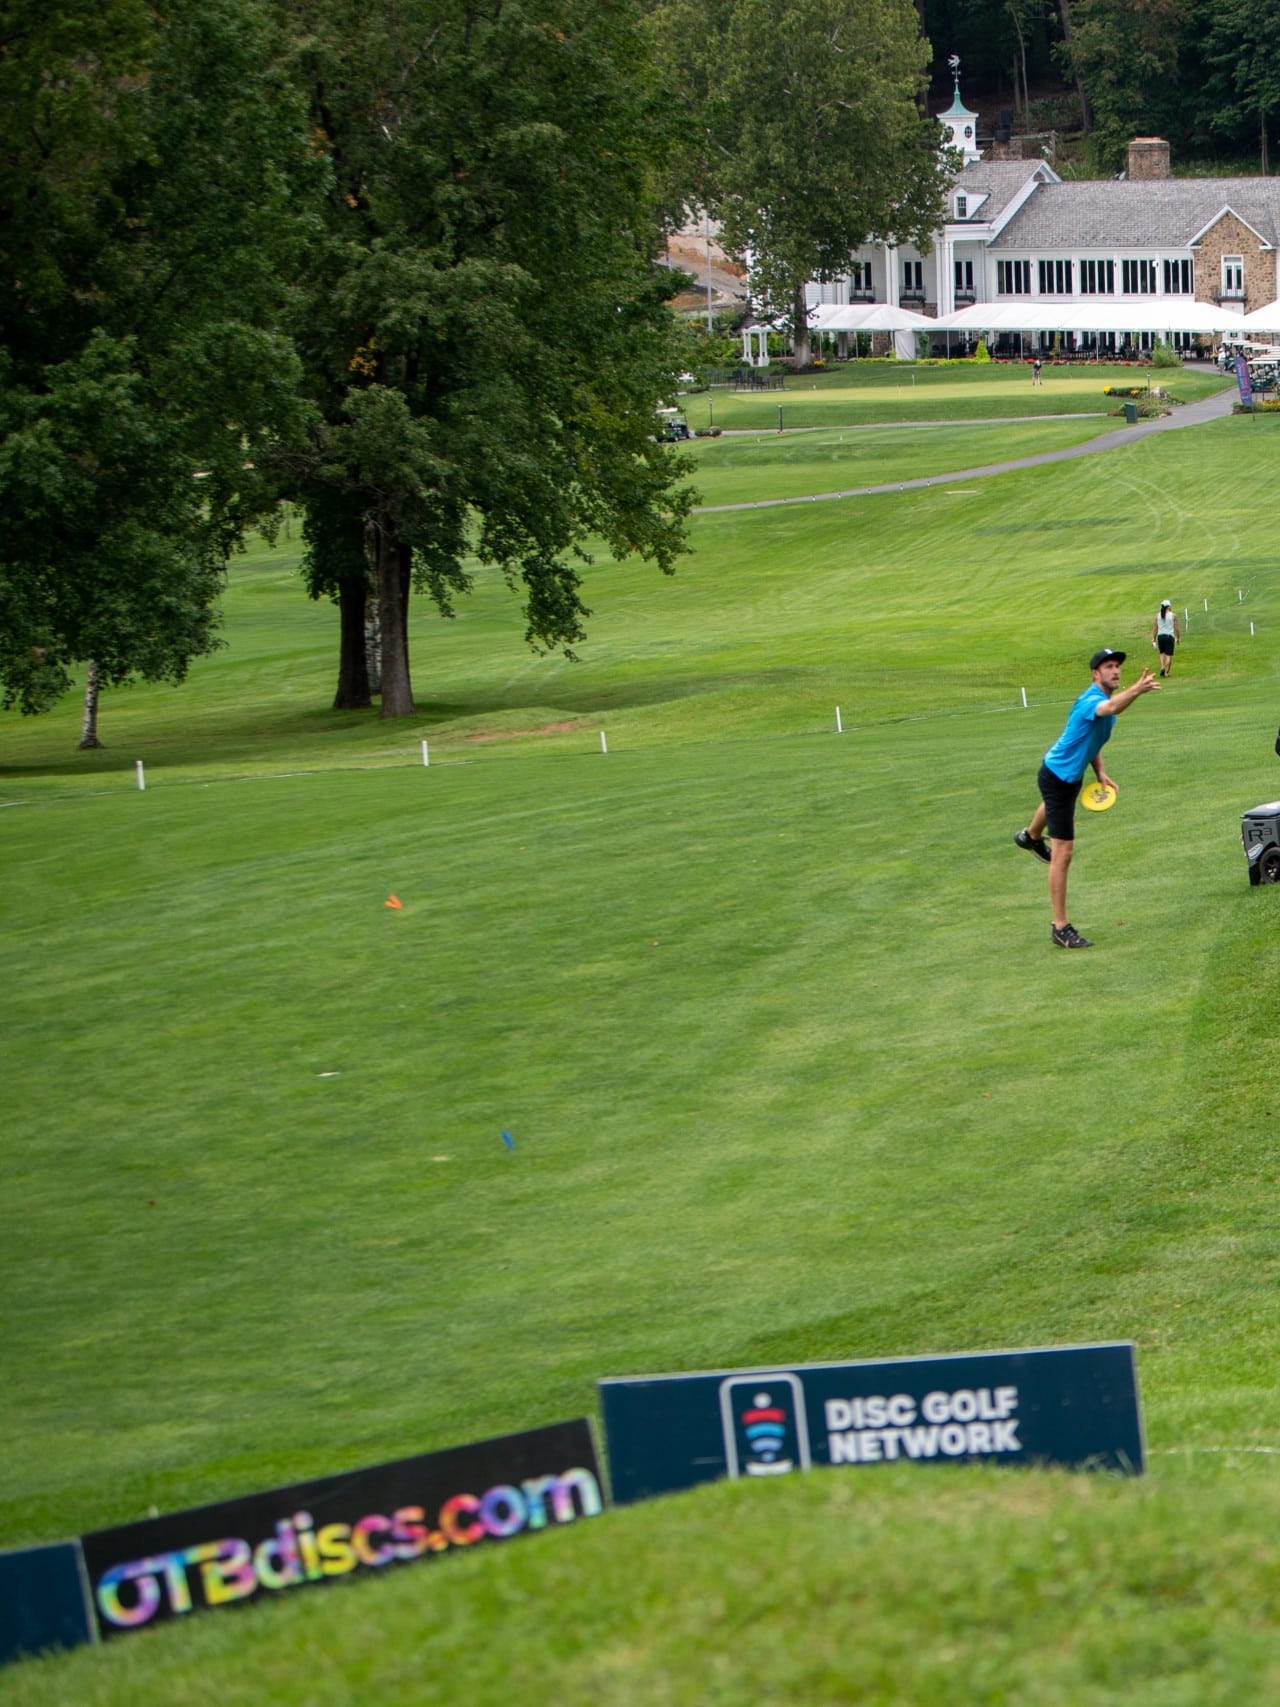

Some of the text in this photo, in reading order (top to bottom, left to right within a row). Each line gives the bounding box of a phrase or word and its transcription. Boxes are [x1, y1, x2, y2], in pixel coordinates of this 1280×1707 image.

[826, 1387, 1018, 1430] DISC GOLF
[829, 1421, 1022, 1462] NETWORK
[98, 1467, 601, 1627] OTBdiscs.com
